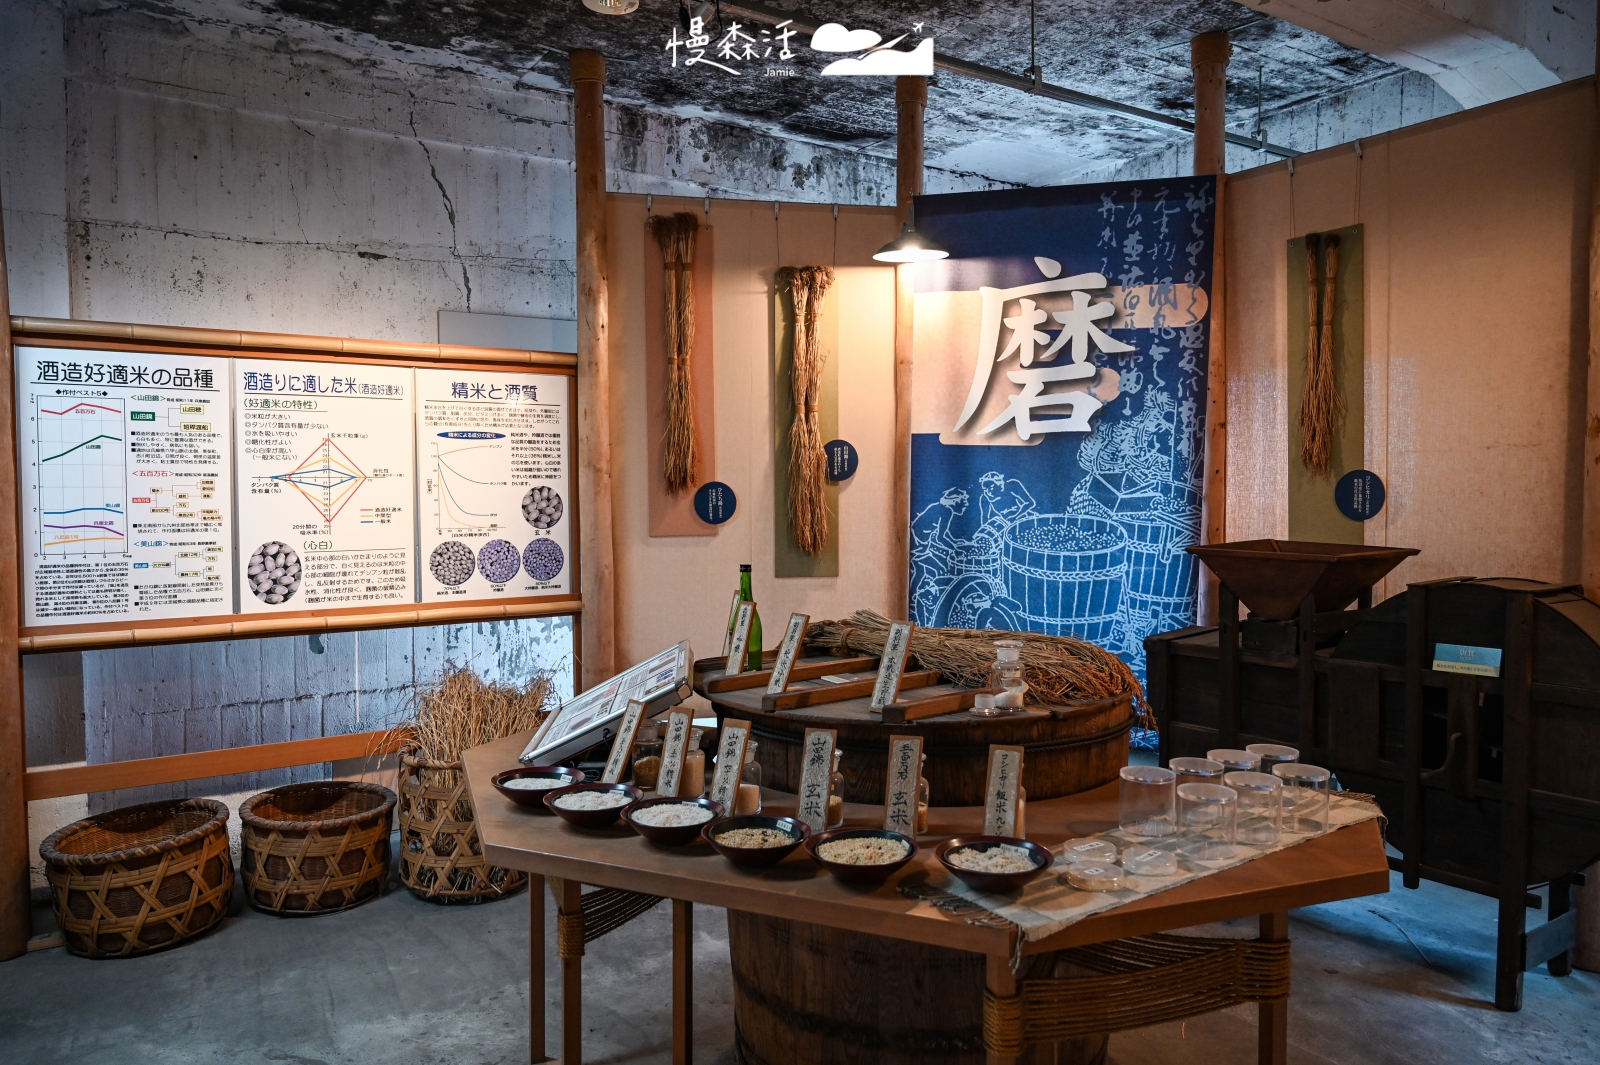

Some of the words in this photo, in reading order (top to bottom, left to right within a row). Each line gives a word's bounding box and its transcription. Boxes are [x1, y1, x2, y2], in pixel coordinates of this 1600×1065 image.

[953, 256, 1135, 440] 磨
[37, 360, 213, 388] 酒造好適米の品種
[244, 398, 318, 410] (好適米の特性)
[451, 382, 538, 402] 精米と酒質
[303, 541, 333, 550] (心白)
[674, 718, 683, 742] 山田錦
[725, 732, 738, 758] 山田錦
[809, 738, 826, 767] 山田錦
[897, 743, 914, 780] 五百万石
[804, 783, 821, 817] 玄米
[890, 791, 910, 826] 玄米
